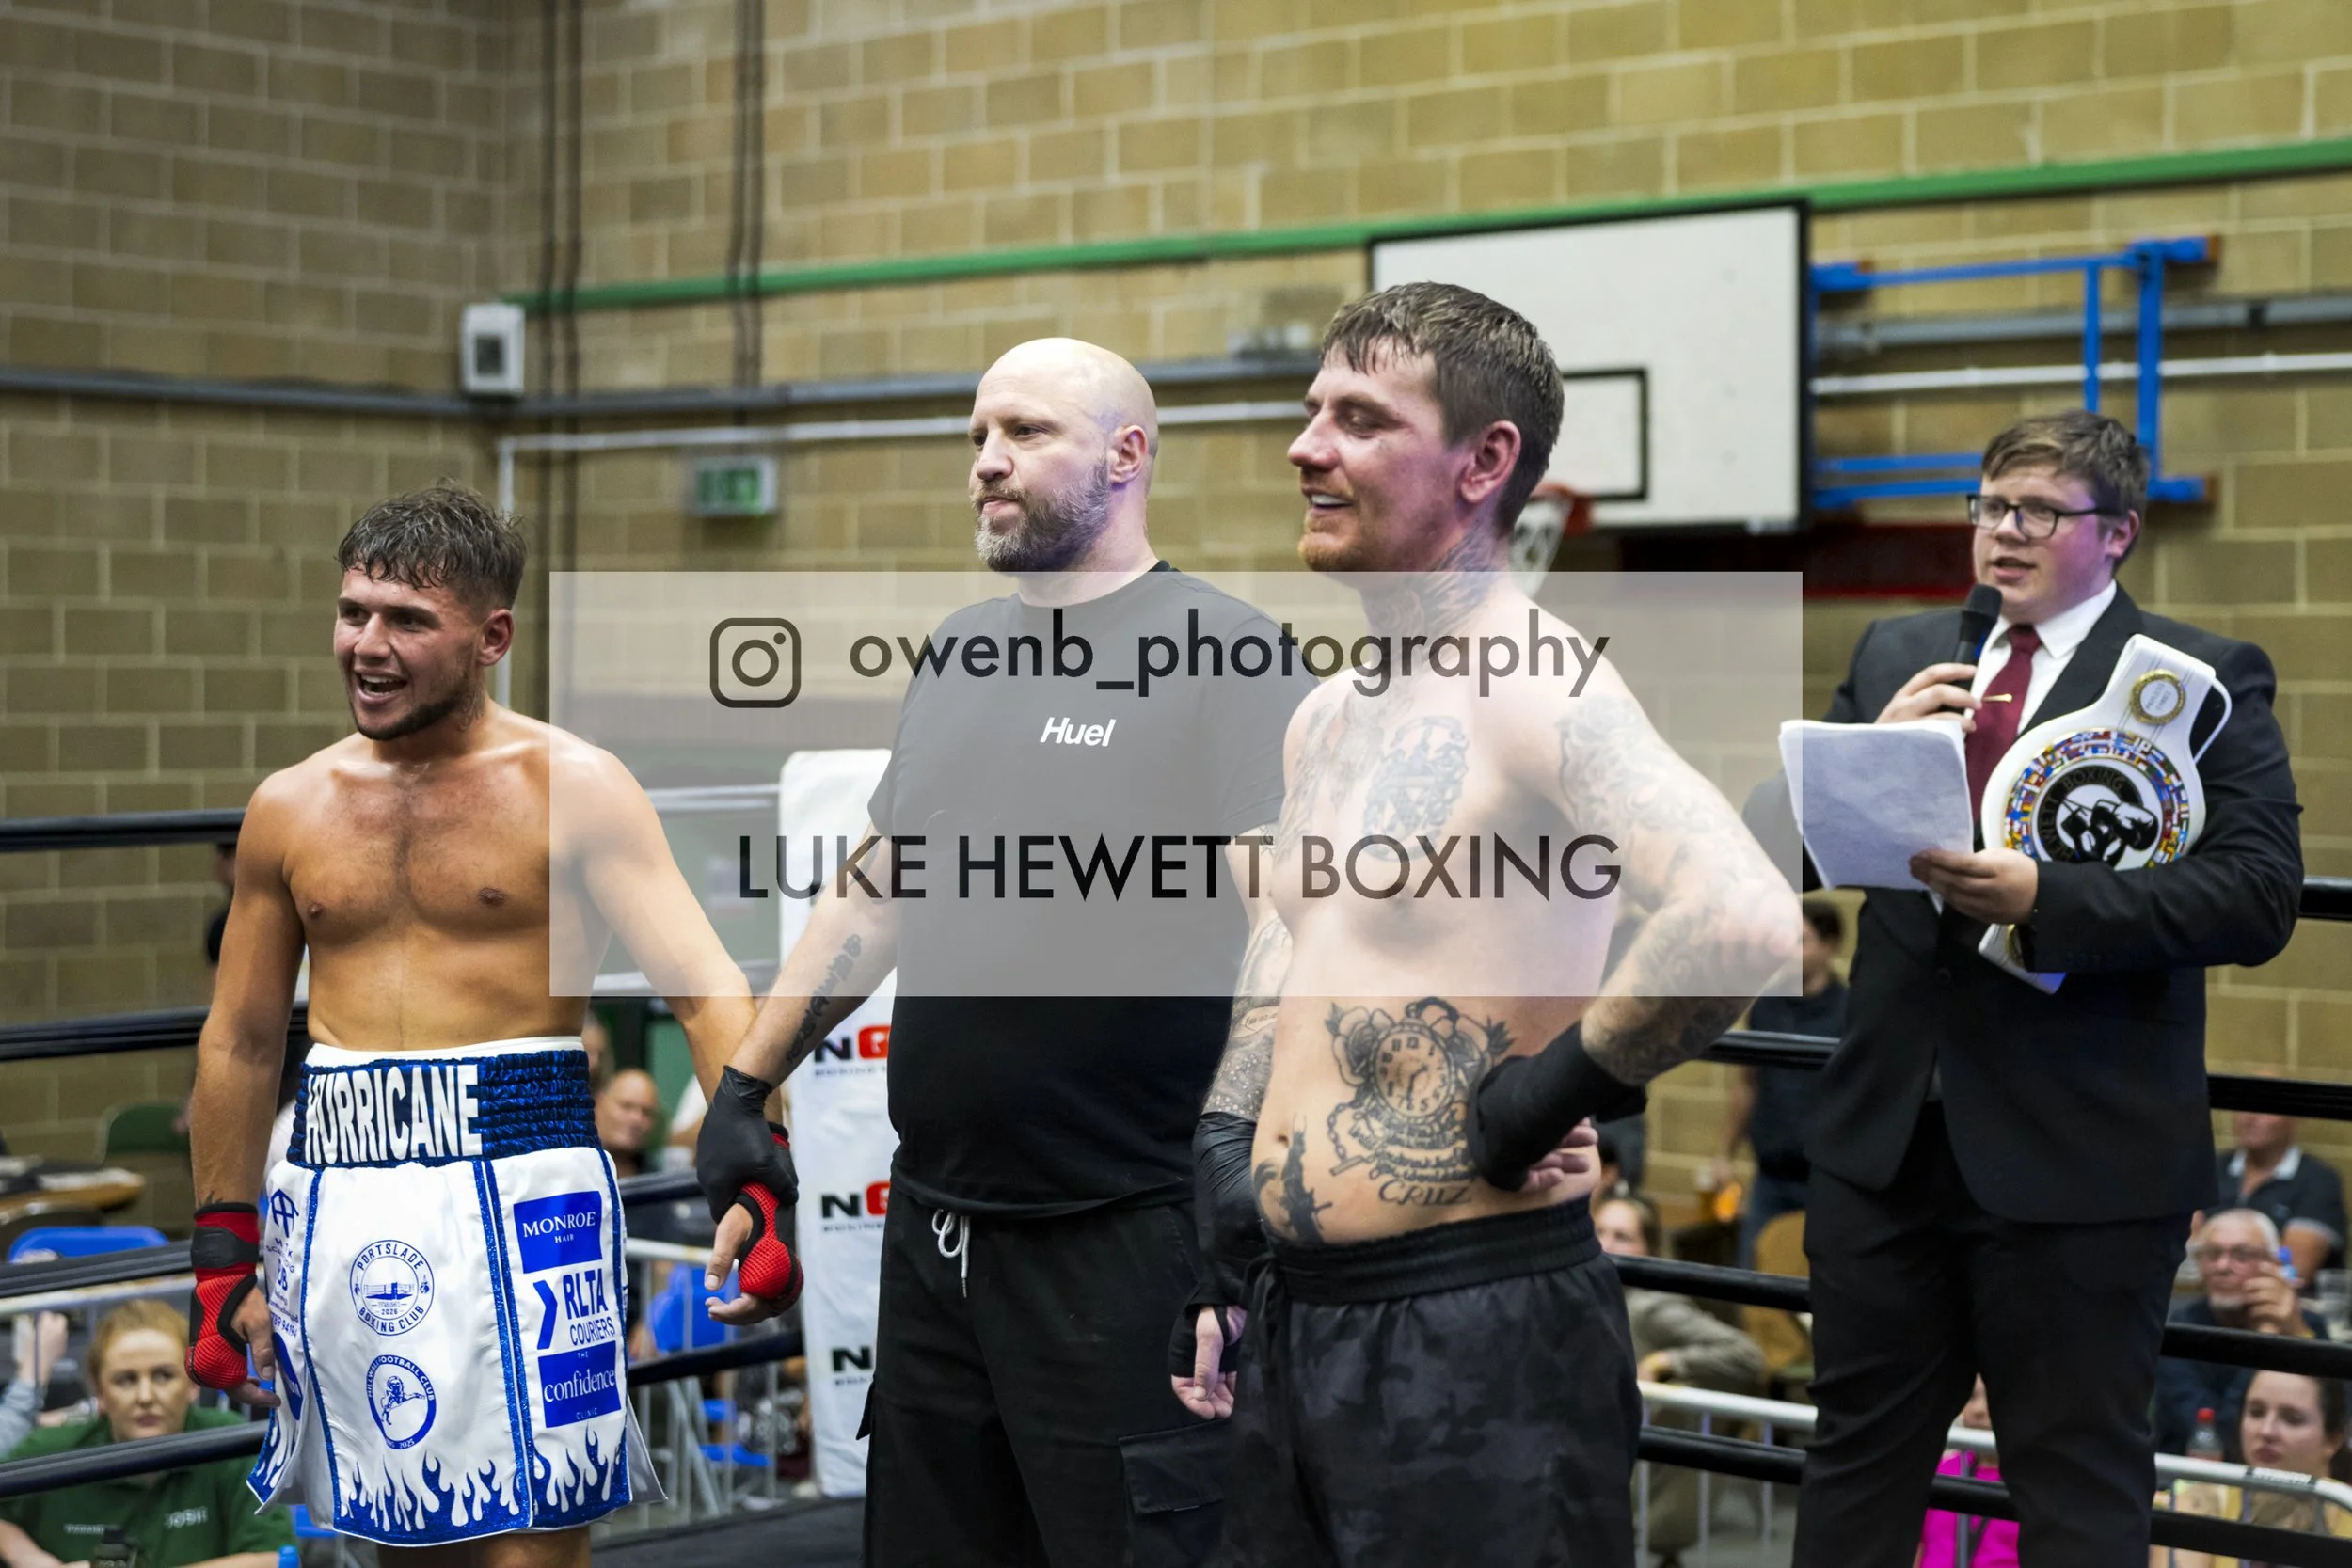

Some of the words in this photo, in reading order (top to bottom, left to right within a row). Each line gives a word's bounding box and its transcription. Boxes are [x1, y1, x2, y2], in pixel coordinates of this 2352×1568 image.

[1040, 717, 1117, 747] Huel
[304, 1064, 483, 1164] HURRICANE
[522, 1212, 596, 1238] MONROE
[554, 1233, 575, 1243] HAIR
[357, 1243, 425, 1271] PORTSLADE
[563, 1268, 609, 1321] RLTA
[358, 1307, 395, 1332] BOXING
[398, 1305, 425, 1330] CLUB
[569, 1316, 616, 1347] COURIERS
[378, 1355, 421, 1377] FOOTBALL
[419, 1375, 435, 1402] CLUB
[544, 1367, 616, 1403] confidence
